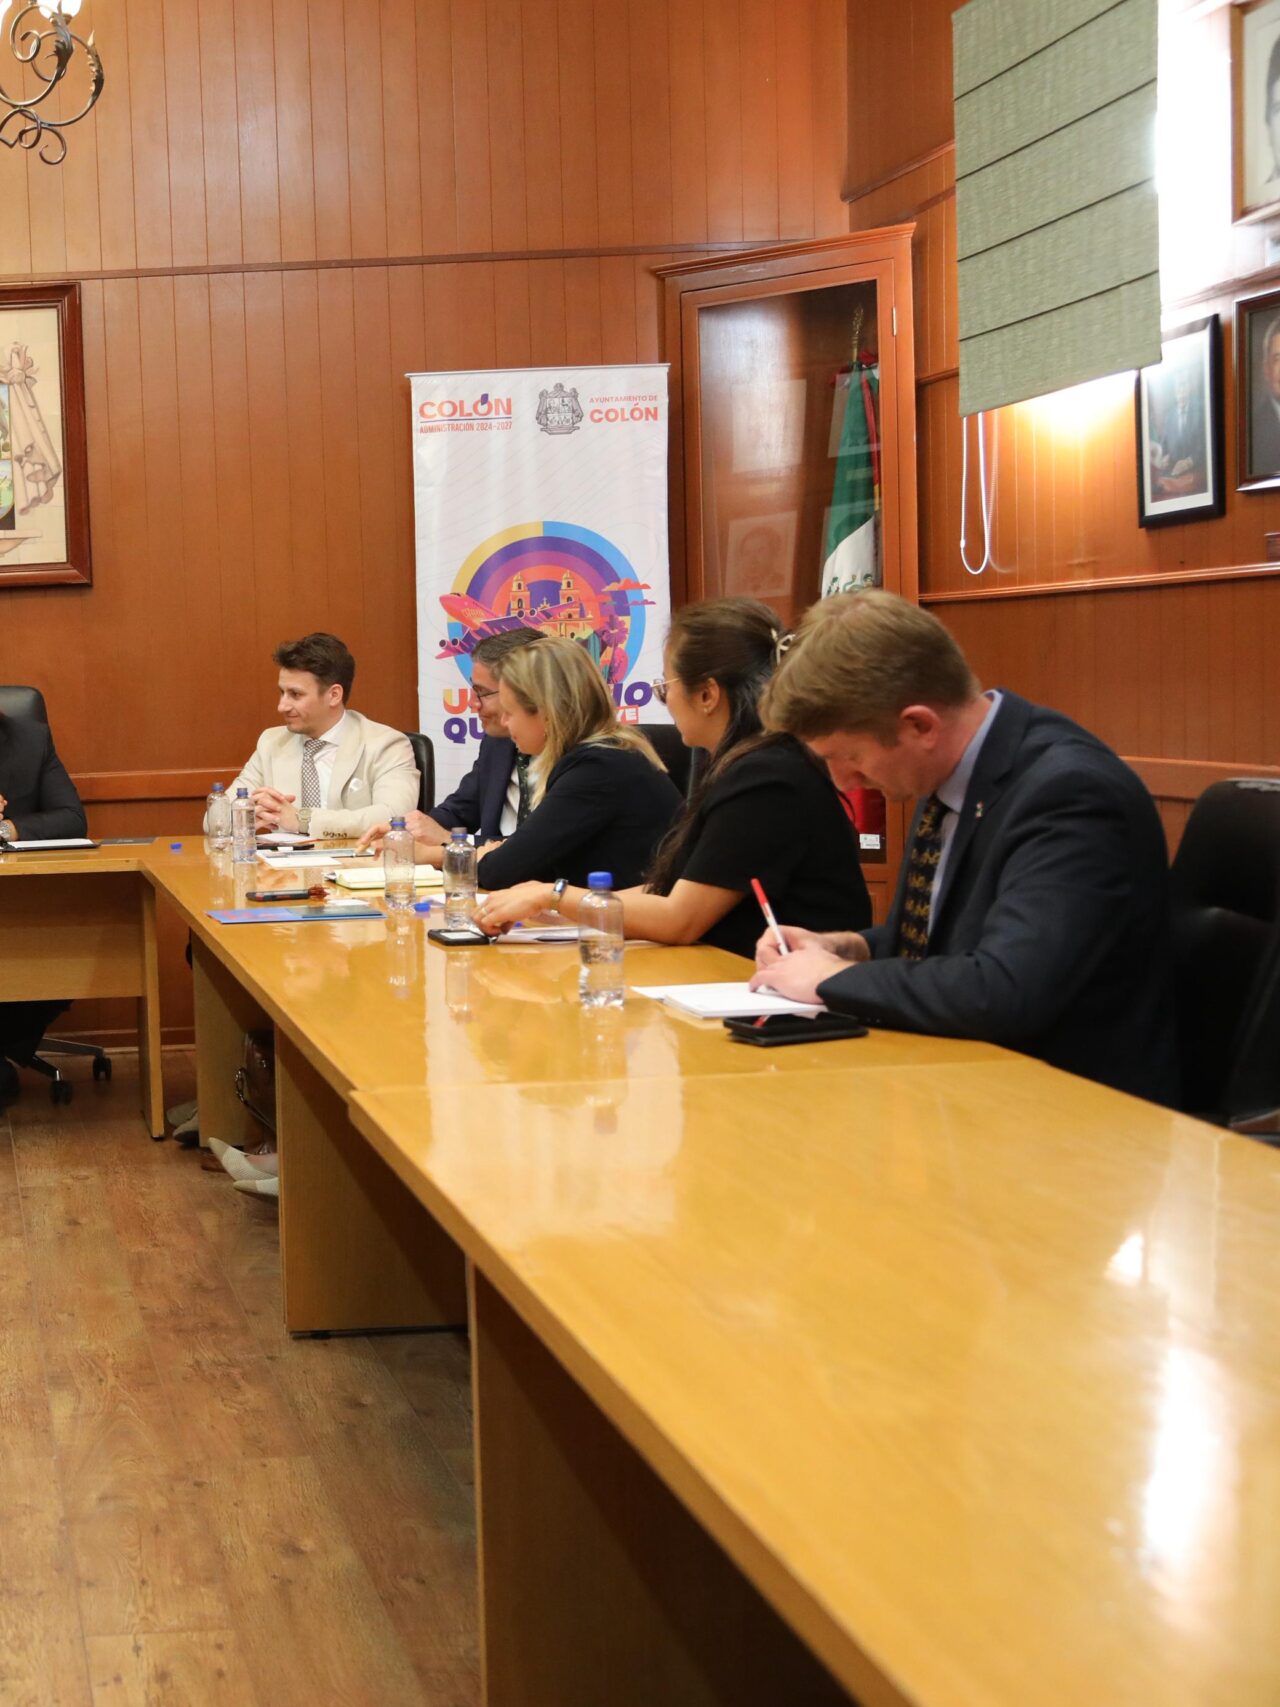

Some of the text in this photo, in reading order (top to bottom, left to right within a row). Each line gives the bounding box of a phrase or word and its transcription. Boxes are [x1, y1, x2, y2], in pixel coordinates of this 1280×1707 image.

[419, 393, 512, 419] COLÓN
[589, 394, 657, 403] AYUNTAMIENTO DE
[590, 402, 658, 423] COLÓN
[420, 421, 512, 434] ADMINISTRACIÓN 2024-2027
